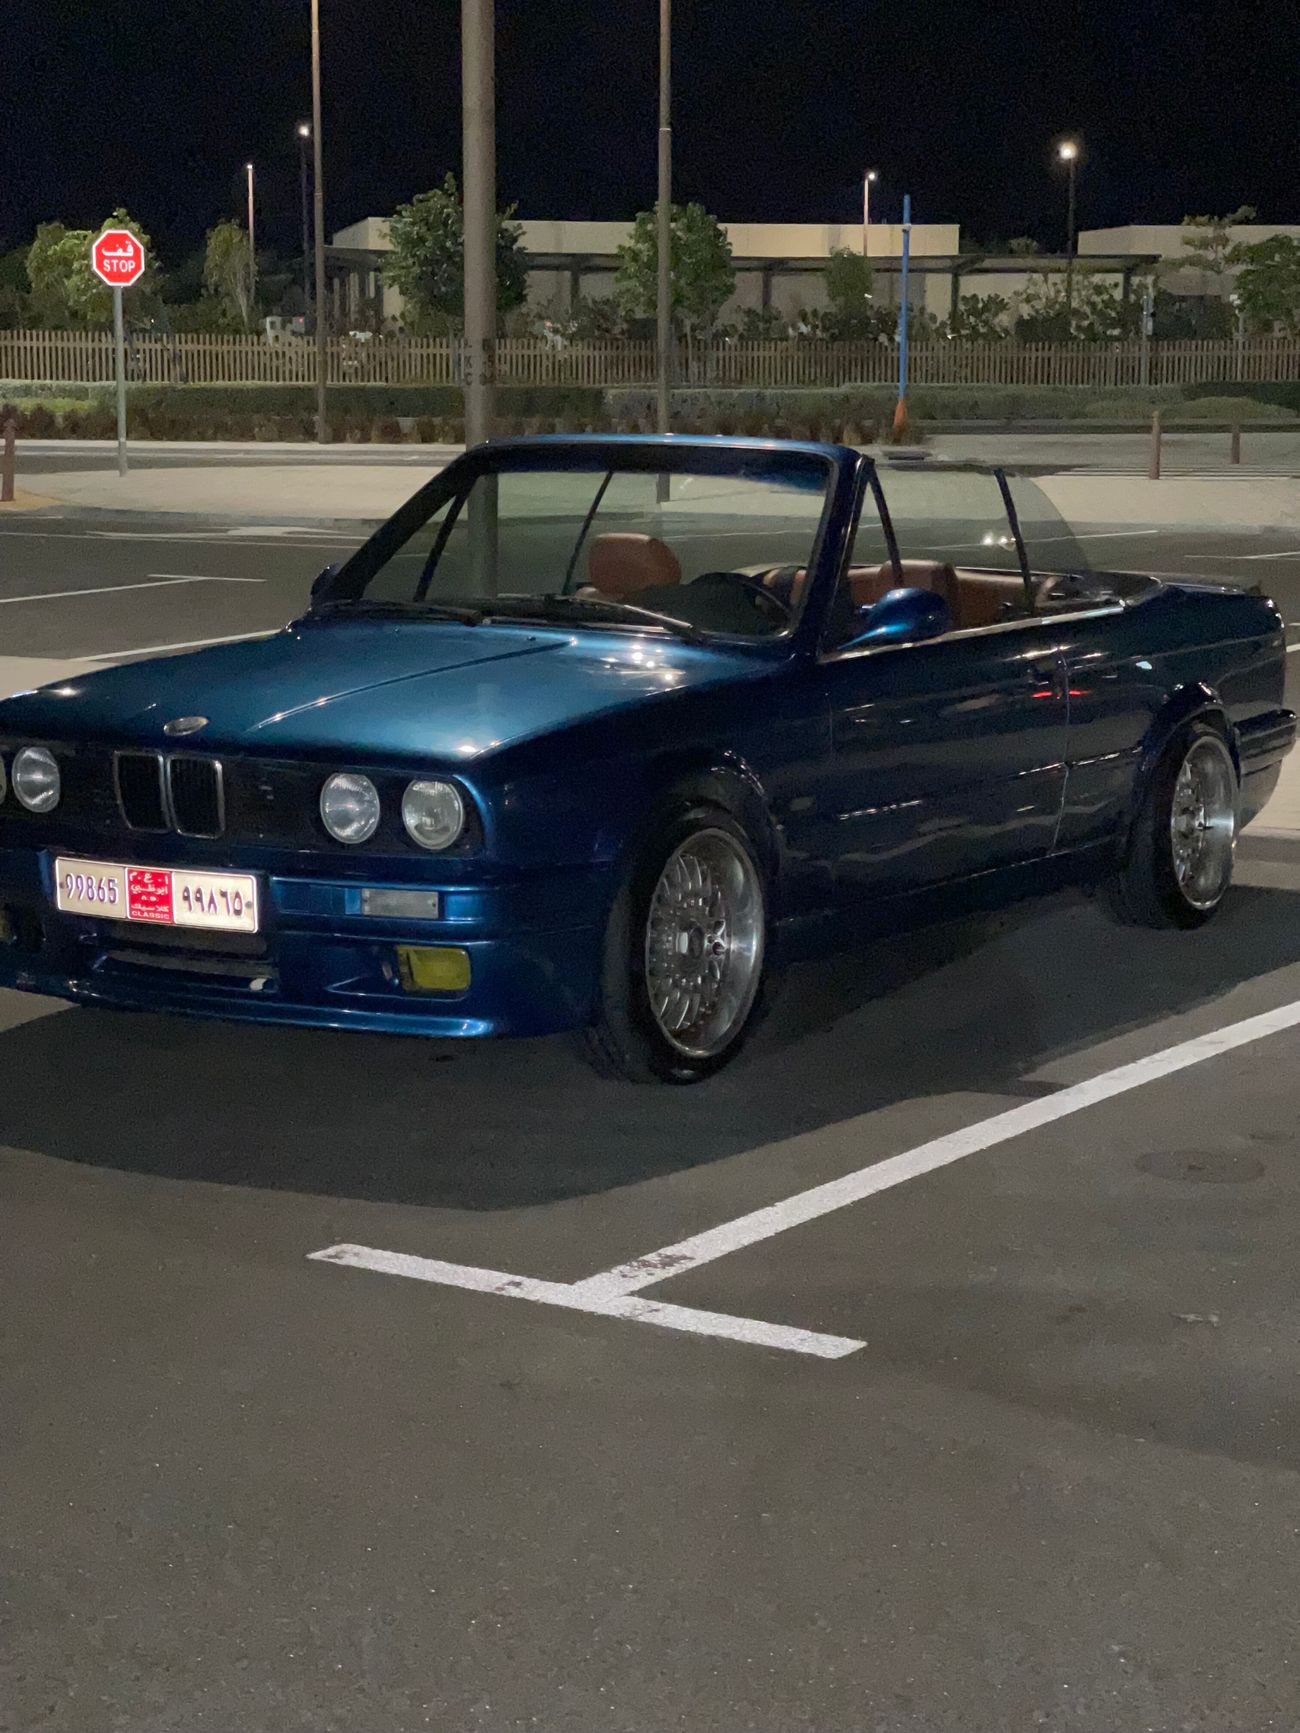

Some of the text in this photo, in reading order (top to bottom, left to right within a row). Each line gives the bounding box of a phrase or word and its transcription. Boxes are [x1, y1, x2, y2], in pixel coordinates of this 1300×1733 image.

[101, 240, 134, 257] قف
[103, 259, 136, 273] STOP
[65, 873, 118, 904] 99865
[182, 886, 243, 917] ٩٩٨٦٥
[131, 910, 170, 920] CLASSIC
